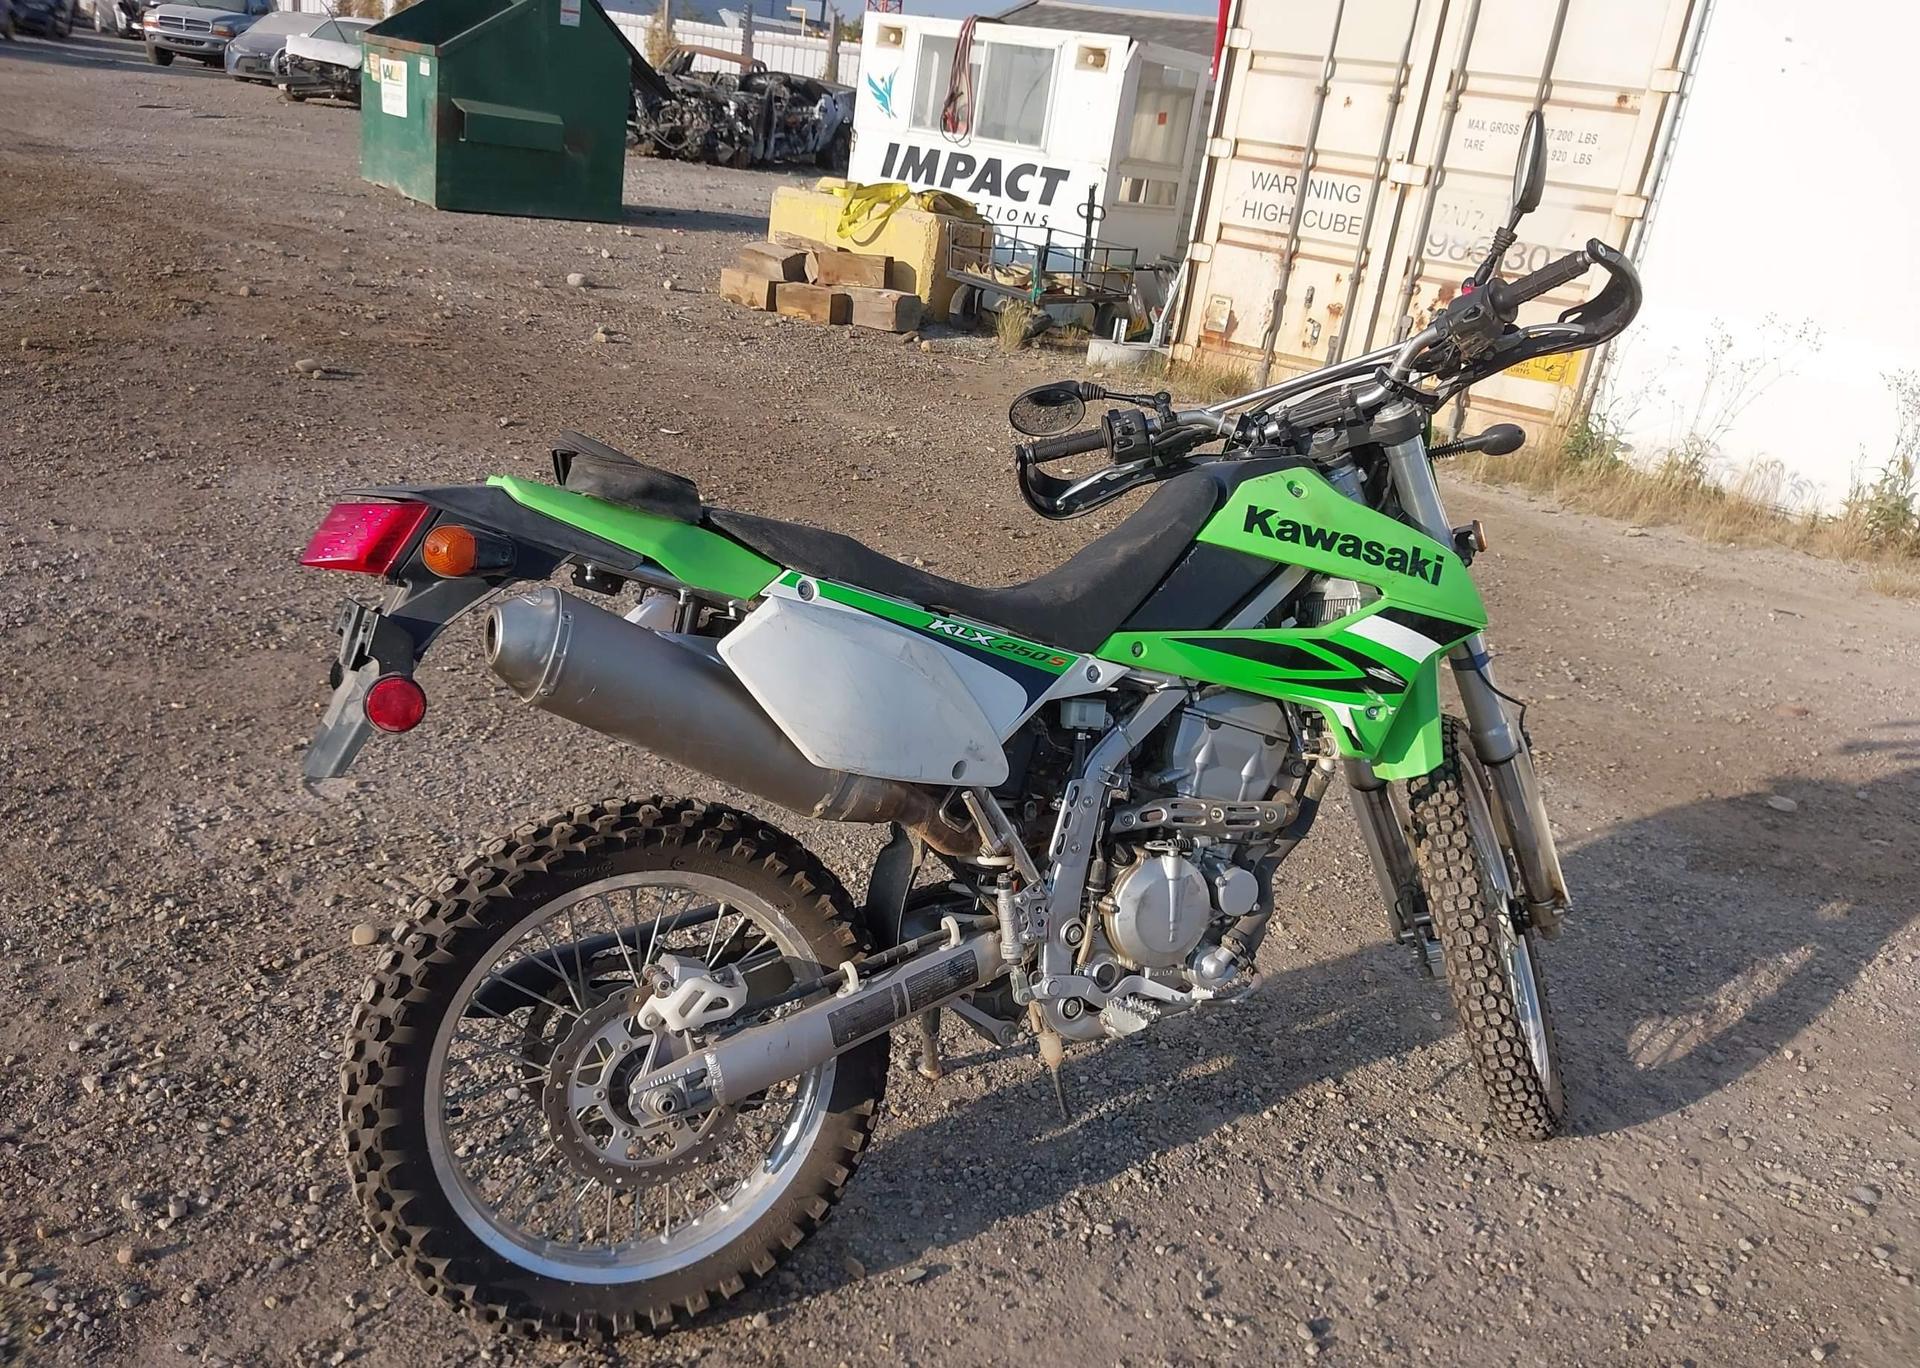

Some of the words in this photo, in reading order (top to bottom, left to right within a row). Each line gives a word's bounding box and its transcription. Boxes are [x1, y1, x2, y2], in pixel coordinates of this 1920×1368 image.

[1490, 121, 1520, 135] GROSS
[1578, 132, 1599, 145] LBS
[1464, 138, 1485, 151] TARE
[1573, 152, 1593, 165] LBS
[880, 142, 1071, 206] IMPACT
[1252, 170, 1361, 203] WARNING
[1242, 200, 1295, 225] HIGH
[1303, 210, 1363, 236] CUBE
[1243, 504, 1445, 586] Kawasaki
[928, 619, 996, 647] KLX
